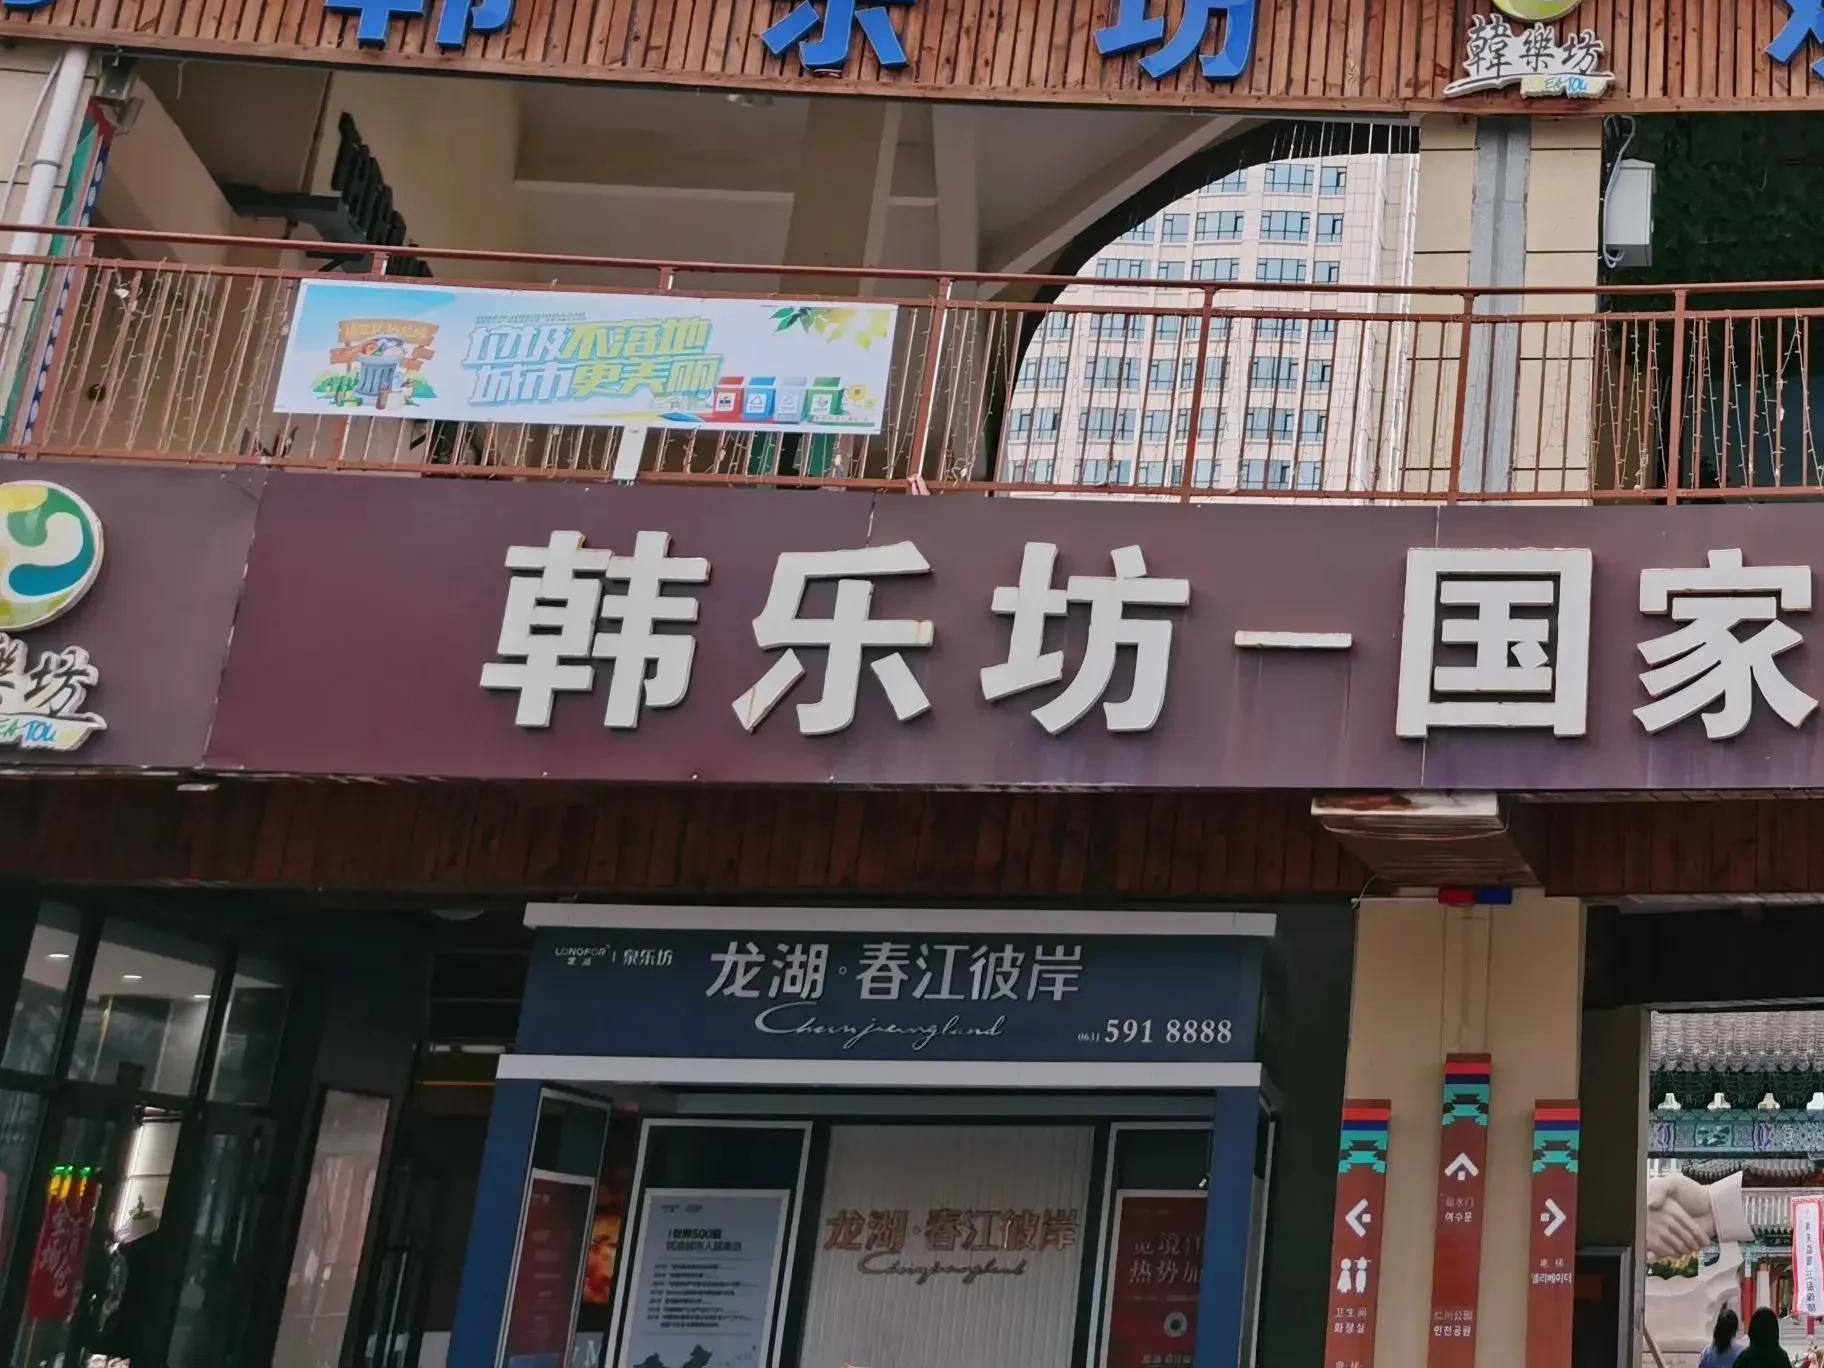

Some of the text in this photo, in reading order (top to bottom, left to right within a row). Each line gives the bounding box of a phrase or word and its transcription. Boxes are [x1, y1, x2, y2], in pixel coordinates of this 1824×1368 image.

[463, 317, 713, 368] 垃圾不落地
[469, 354, 723, 404] 城市更美丽
[1104, 1019, 1153, 1044] 591
[1165, 1019, 1233, 1044] 8888
[1335, 1307, 1367, 1318] 卫生间
[1333, 1322, 1366, 1334] 화장실
